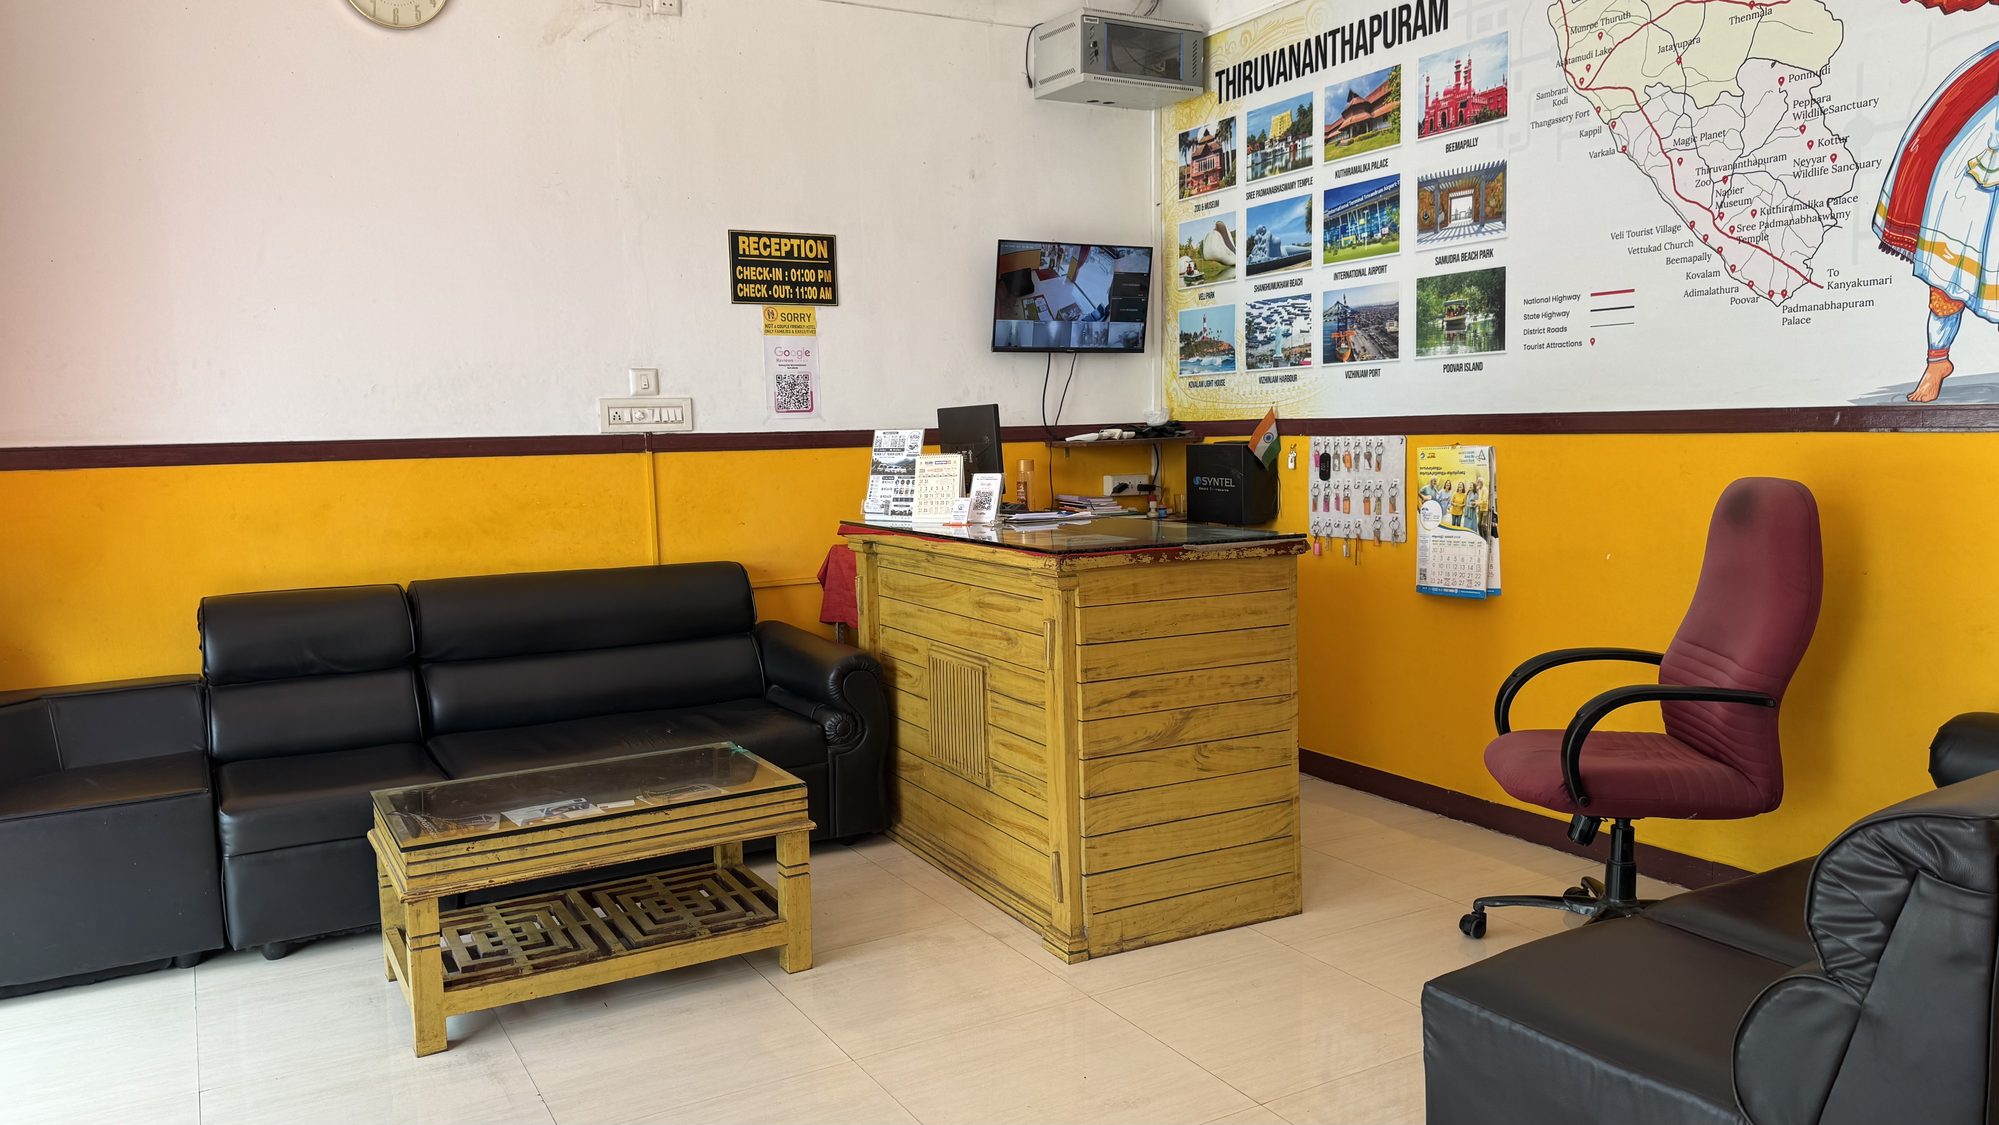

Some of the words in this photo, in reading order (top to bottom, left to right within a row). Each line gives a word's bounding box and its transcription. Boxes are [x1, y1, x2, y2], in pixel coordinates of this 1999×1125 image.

[415, 5, 422, 22] 5
[1729, 8, 1772, 25] Thenmala
[1570, 21, 1598, 35] Munroe
[1600, 11, 1631, 27] Thuruth
[1658, 36, 1700, 54] Jatayupara
[1216, 0, 1448, 104] THIRUVANANTHAPURAM
[1556, 50, 1594, 68] Astamudi
[1595, 46, 1612, 58] Lake
[1536, 86, 1568, 100] Sambrani
[1552, 96, 1568, 108] Kodi
[1792, 94, 1832, 110] Peppara
[1530, 112, 1574, 130] Thangassery
[1575, 109, 1590, 120] Fort
[1579, 126, 1602, 138] Kappil
[1673, 134, 1697, 147] Magic
[1700, 130, 1726, 142] Planet
[1445, 137, 1479, 154] BEEMAPALLY
[1589, 148, 1616, 159] Varkala
[1695, 153, 1787, 176] Thiruvananthapuram
[1793, 155, 1826, 168] Neyyar
[1335, 163, 1370, 179] KUTHIRAMALIKA
[1371, 158, 1388, 170] PALACE
[1792, 166, 1829, 179] Wildlife
[1246, 190, 1255, 200] SREE
[1297, 177, 1313, 188] TEMPLE
[1695, 178, 1711, 188] Zoo
[1715, 186, 1744, 198] Napier
[1204, 200, 1220, 210] MUSEUM
[1715, 198, 1752, 210] Museum
[1760, 200, 1824, 216] Kuthiramalika
[1827, 195, 1858, 208] Palace
[1610, 230, 1624, 240] Veli
[1627, 227, 1653, 239] Tourist
[1656, 224, 1682, 235] Village
[1737, 223, 1756, 233] Sree
[1737, 233, 1769, 245] Temple
[738, 236, 828, 258] RECEPTION
[1627, 244, 1662, 255] Vettukad
[1664, 240, 1694, 251] Church
[1435, 254, 1460, 266] SAMUDRA
[1461, 251, 1478, 262] BEACH
[1479, 248, 1494, 259] PARK
[1666, 252, 1712, 265] Beemapally
[736, 266, 782, 281] CHECK-IN
[791, 268, 815, 282] 01:00
[818, 270, 831, 282] PM
[1334, 268, 1367, 281] INTERNATIONAL
[1368, 264, 1387, 276] AIRPORT
[1686, 269, 1720, 280] Kovalam
[1827, 269, 1839, 277] To
[1290, 278, 1303, 288] BEACH
[1827, 275, 1892, 290] Kanyakumari
[796, 286, 817, 299] 11:00
[820, 287, 832, 300] AM
[1206, 291, 1215, 299] PARK
[1684, 286, 1739, 297] Adimalathura
[1524, 296, 1550, 305] National
[1552, 294, 1581, 303] Highway
[1730, 296, 1760, 305] Poovar
[1782, 299, 1874, 313] Padmanabhapuram
[780, 312, 811, 322] SORRY
[1542, 310, 1570, 320] Highway
[1782, 316, 1811, 326] Palace
[1546, 340, 1582, 349] Attractions
[774, 346, 810, 359] Google
[1345, 370, 1368, 379] VIZHINJAM
[1369, 368, 1381, 377] PORT
[1443, 363, 1463, 373] POOVAR
[1464, 362, 1483, 372] ISLAND
[1279, 374, 1297, 383] HARBOUR
[1202, 476, 1235, 487] SYNTEL
